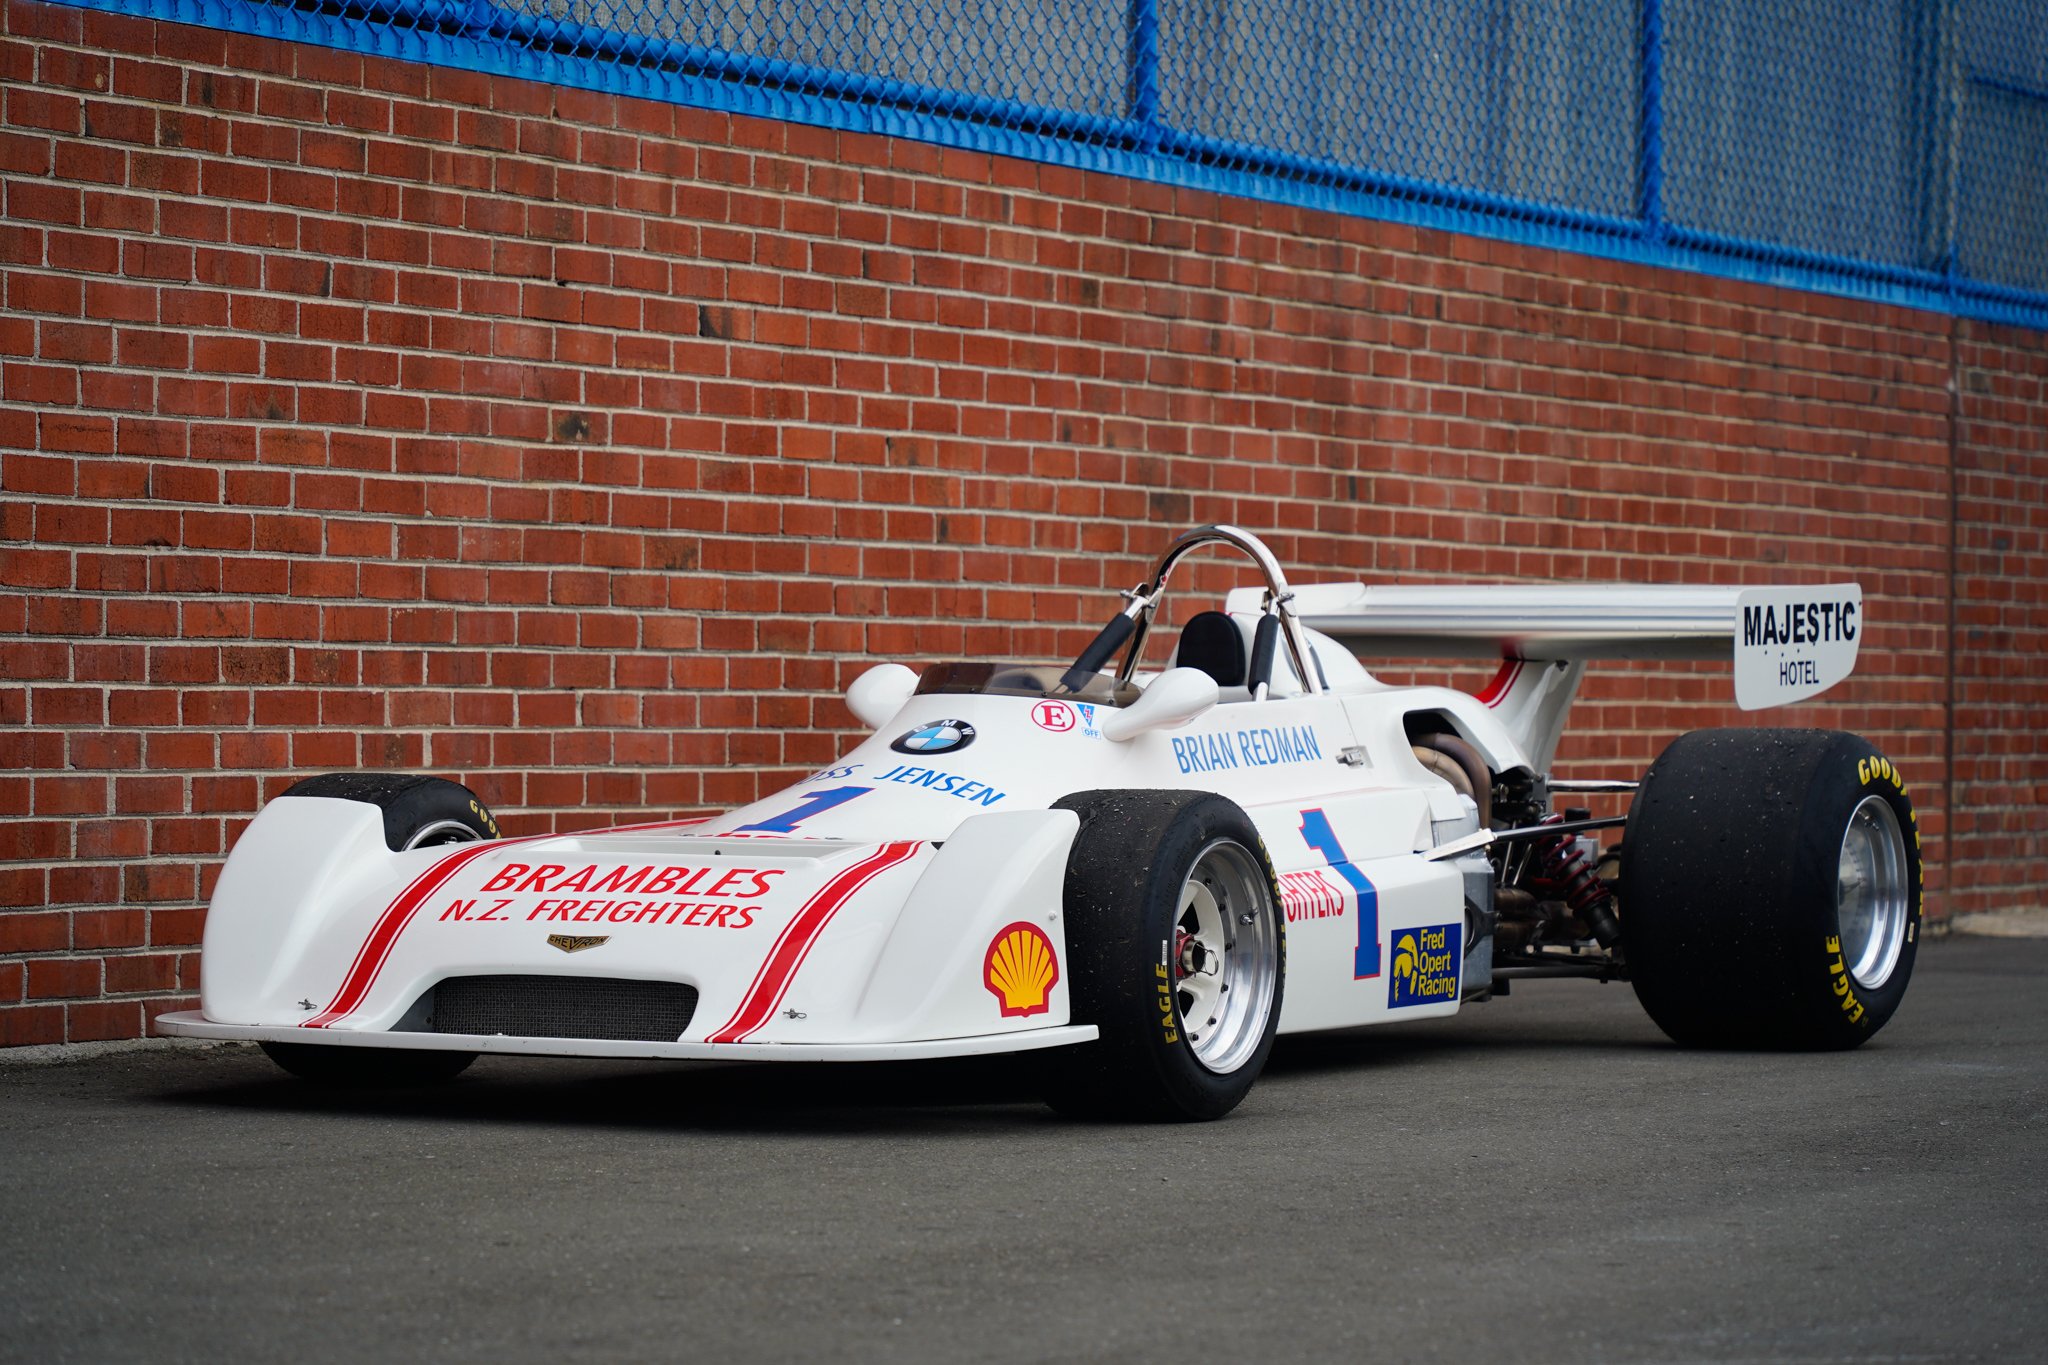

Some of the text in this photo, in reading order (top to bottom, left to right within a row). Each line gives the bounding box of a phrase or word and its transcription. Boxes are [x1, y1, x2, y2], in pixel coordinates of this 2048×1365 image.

[1744, 601, 1856, 647] MAJESTIC
[1780, 659, 1820, 686] HOTEL
[1041, 705, 1066, 728] E
[1084, 728, 1099, 738] OFF
[1171, 725, 1322, 774] BRIAN REDMAN
[873, 764, 1006, 807] JENSEN
[734, 785, 875, 833] 1
[480, 863, 786, 898] BRAMBLES
[1298, 807, 1382, 981] 1
[438, 899, 763, 929] N.Z. FREIGHTERS
[549, 935, 609, 950] CHEVRON
[1420, 927, 1445, 951] Fred
[1419, 950, 1451, 978] Opert
[1825, 934, 1865, 1024] EAGLE
[1417, 972, 1456, 999] Racing
[1155, 963, 1178, 1044] EAGLE
